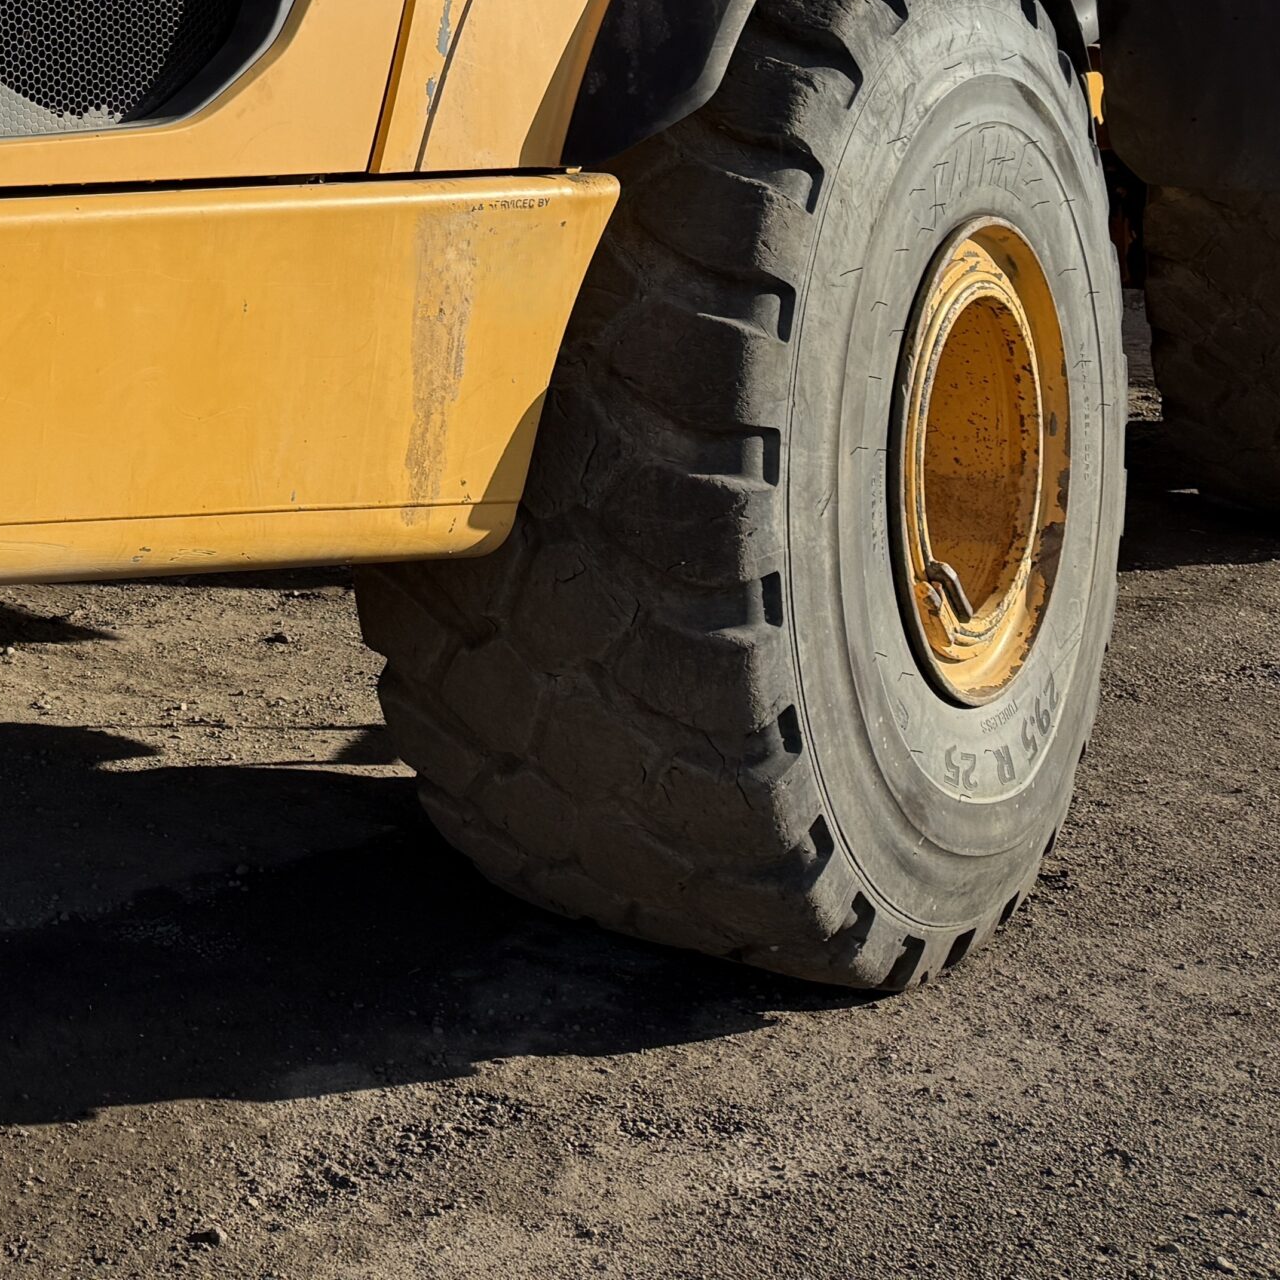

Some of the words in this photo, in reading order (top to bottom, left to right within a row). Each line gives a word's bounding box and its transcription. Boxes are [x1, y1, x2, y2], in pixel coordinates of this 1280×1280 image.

[537, 197, 551, 208] BY
[1021, 670, 1060, 766] 29.5
[943, 744, 979, 792] 25
[991, 744, 1017, 786] R
